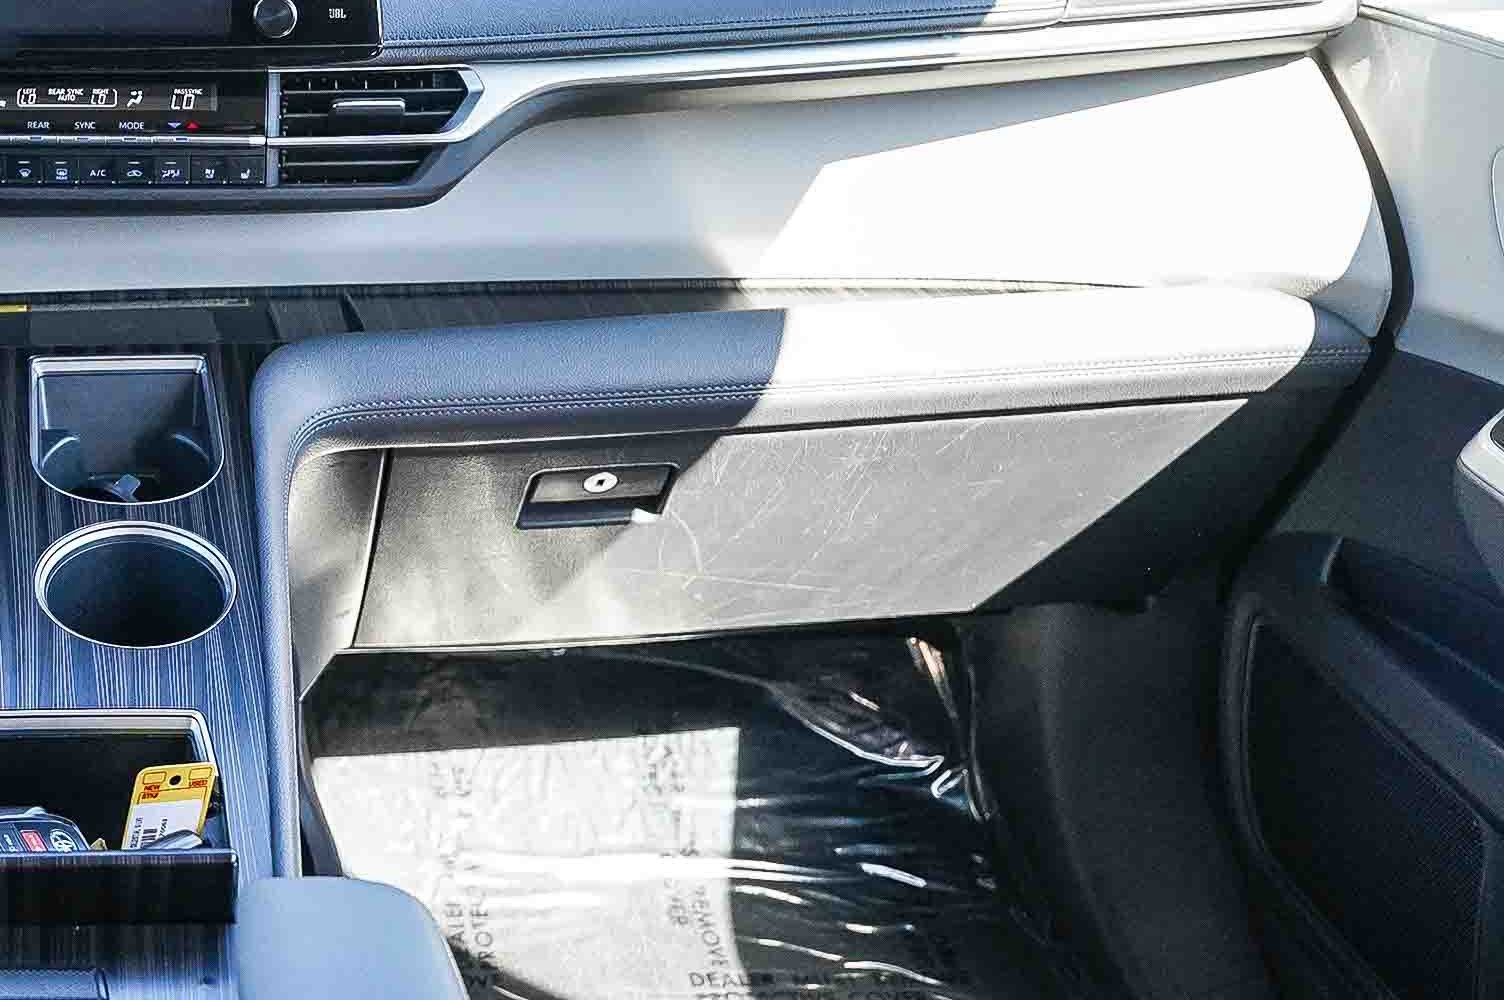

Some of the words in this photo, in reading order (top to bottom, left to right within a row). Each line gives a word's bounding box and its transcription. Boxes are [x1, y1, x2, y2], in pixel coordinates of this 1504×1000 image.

[48, 88, 66, 96] REAR
[67, 88, 84, 96] SYNC
[57, 94, 76, 102] AUTO
[170, 94, 195, 111] LO
[27, 121, 50, 130] REAR
[74, 121, 96, 131] SYNC
[118, 121, 145, 131] MODE
[89, 168, 107, 177] A/C
